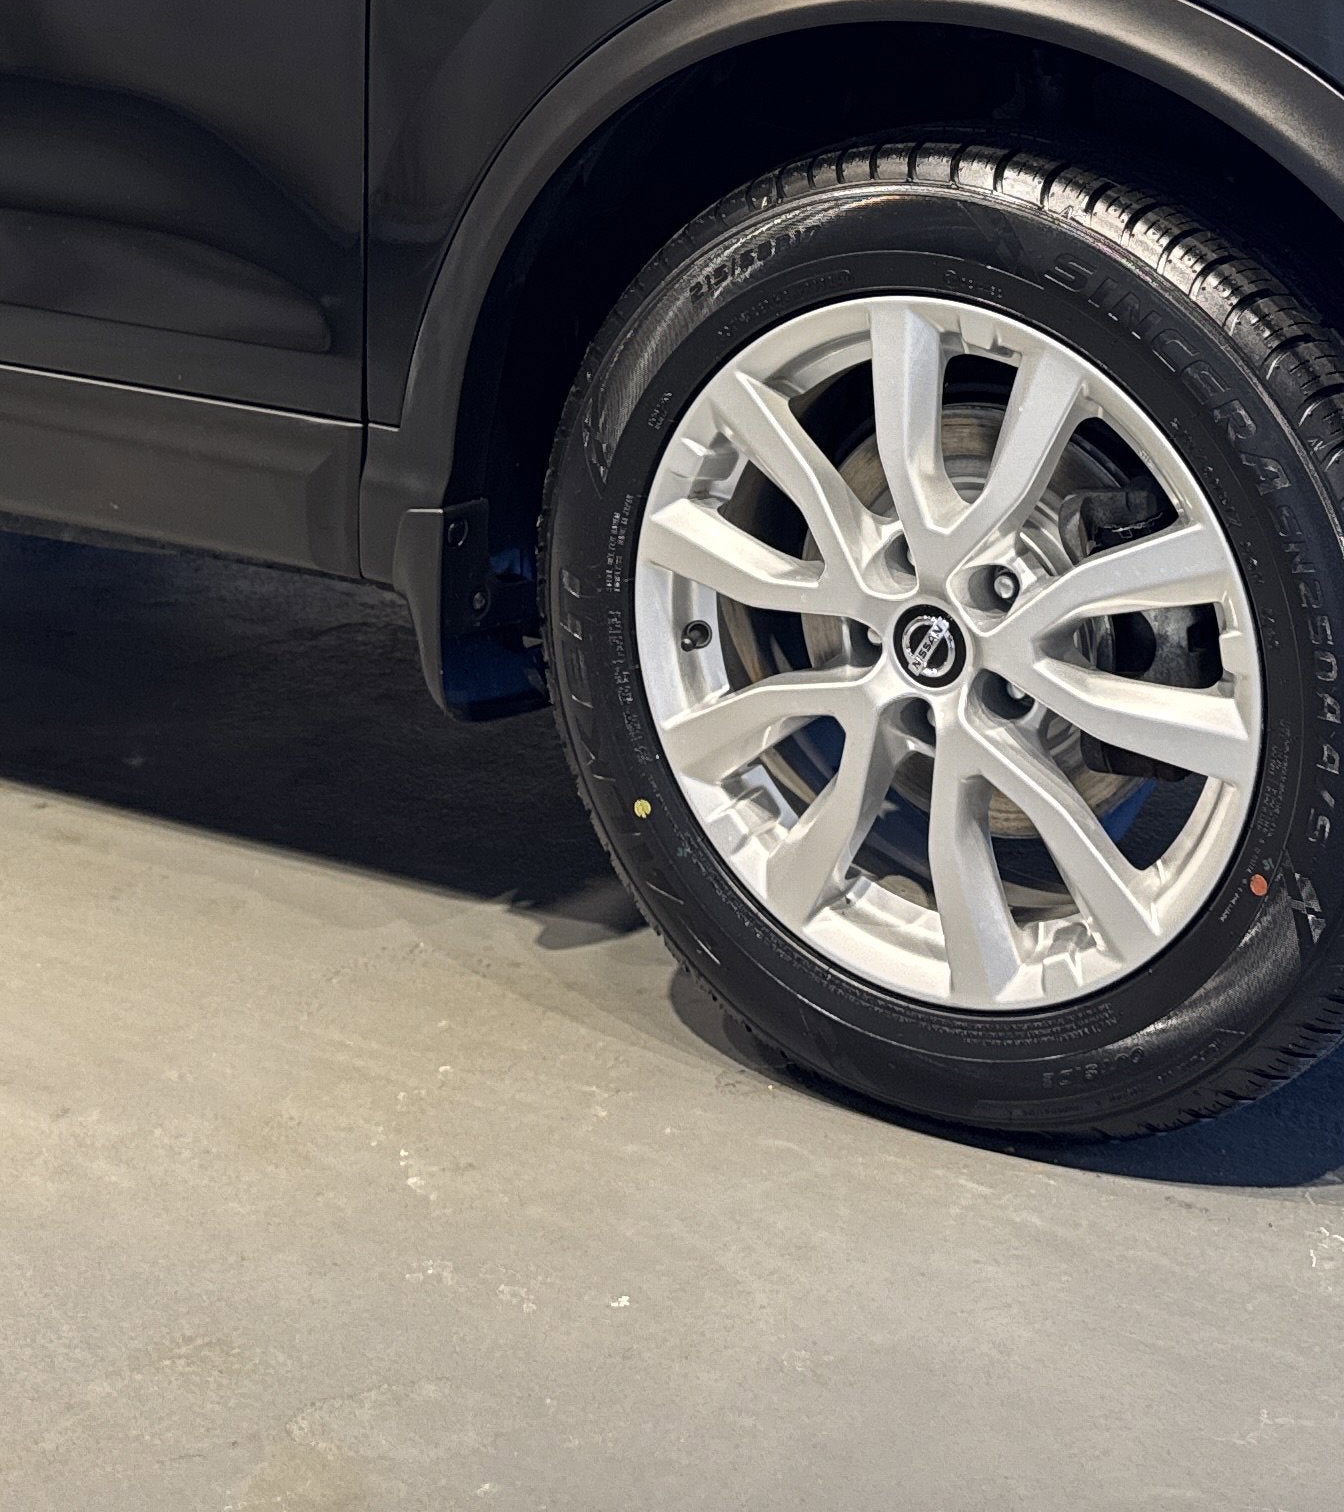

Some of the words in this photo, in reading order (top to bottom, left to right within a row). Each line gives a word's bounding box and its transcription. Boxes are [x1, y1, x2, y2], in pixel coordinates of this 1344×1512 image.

[1042, 250, 1294, 498] SINCERA
[1267, 500, 1343, 726] SN250A
[912, 624, 944, 669] NISSAN
